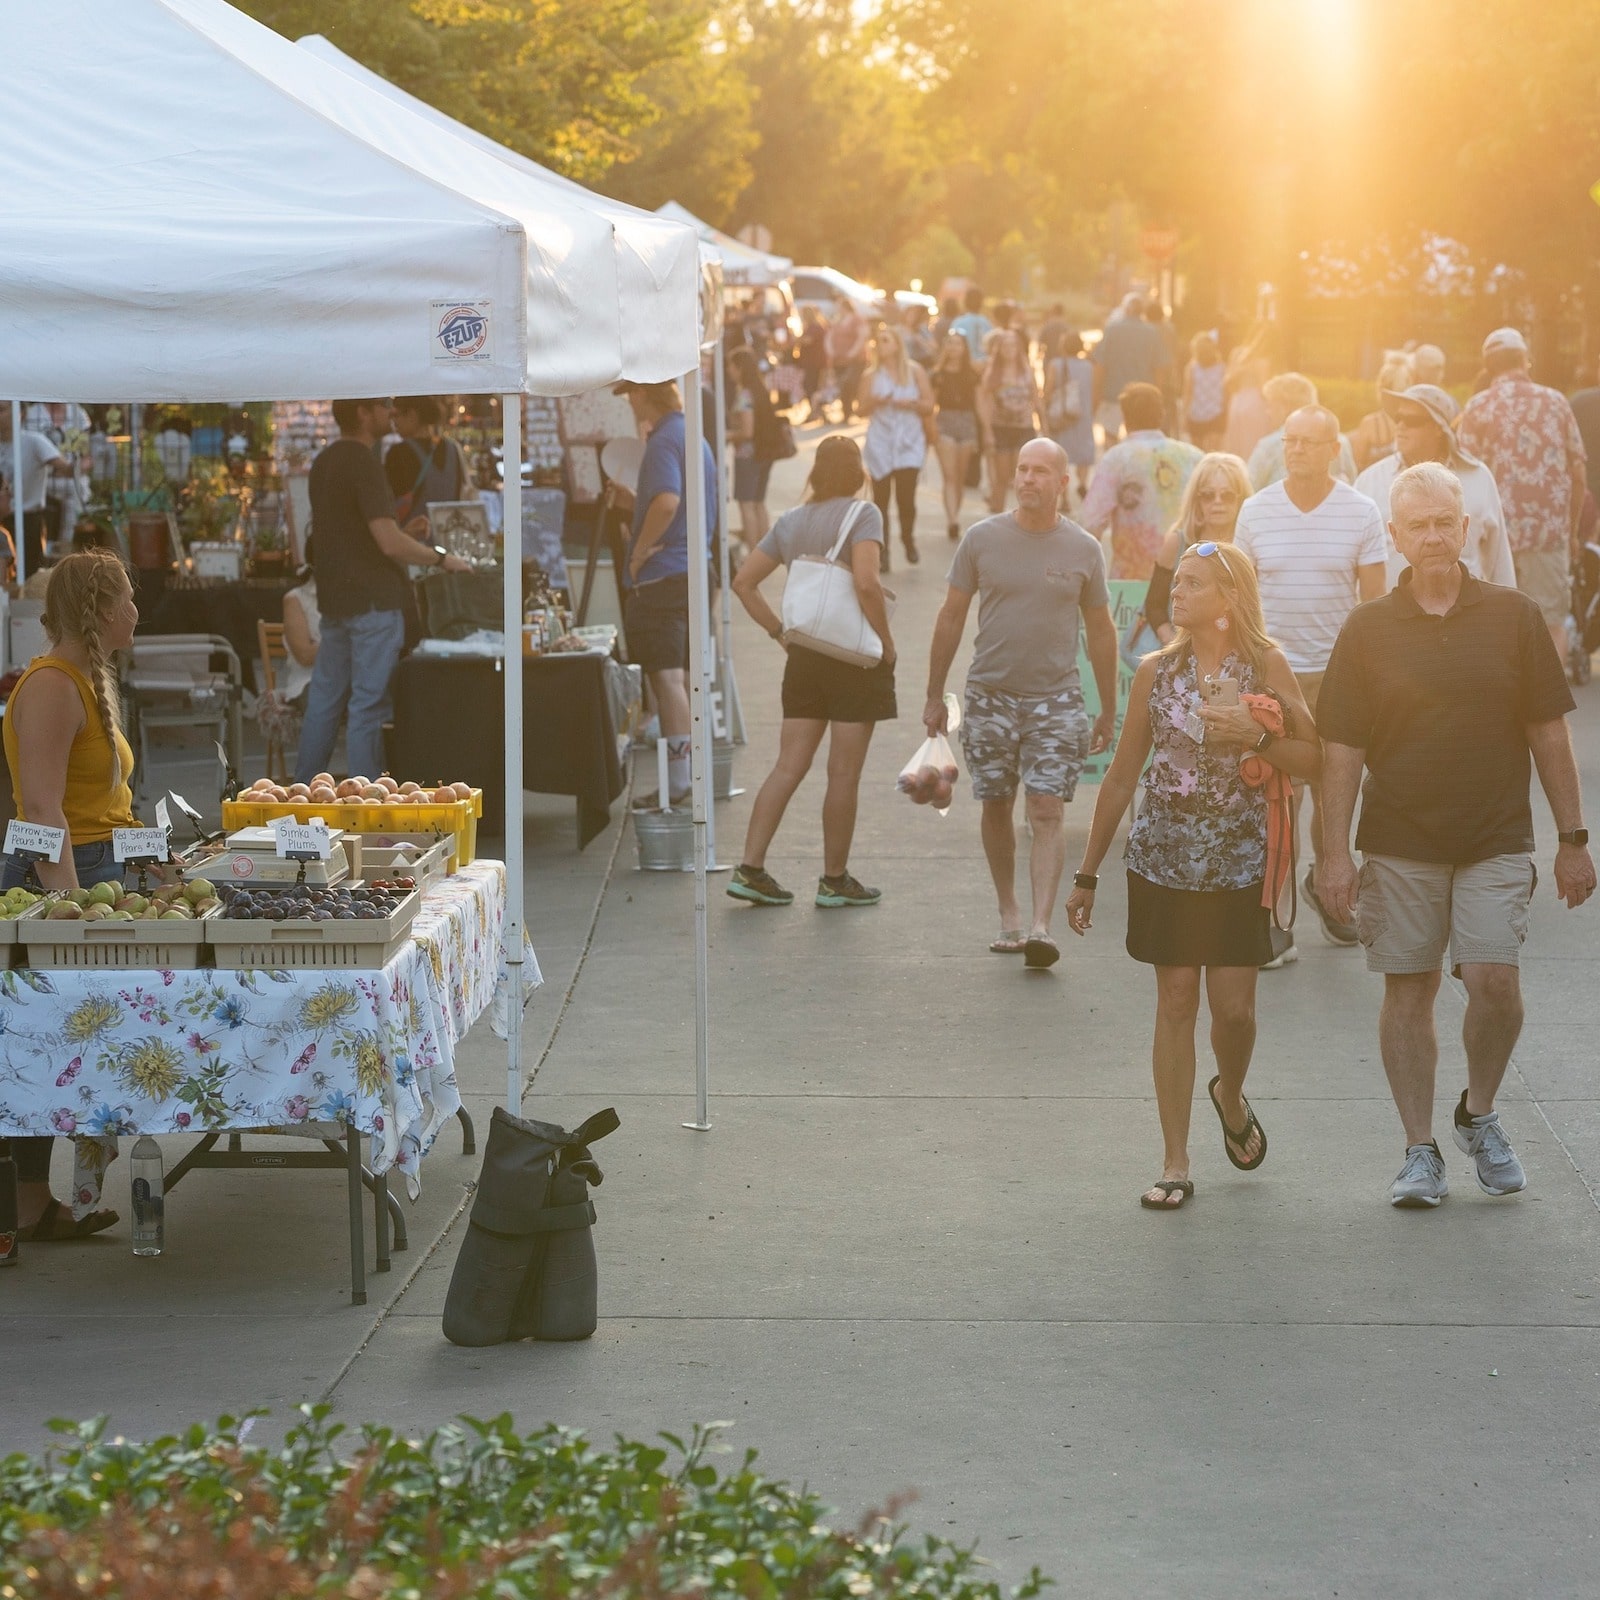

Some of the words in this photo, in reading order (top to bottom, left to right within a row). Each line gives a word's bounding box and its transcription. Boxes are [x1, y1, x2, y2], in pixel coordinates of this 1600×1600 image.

[10, 820, 41, 836] Harrow
[43, 828, 61, 839] Sweet
[114, 830, 127, 840] Red
[280, 826, 310, 839] Simka
[12, 834, 35, 847] Pears
[288, 839, 317, 850] Plums
[121, 842, 143, 854] Pears
